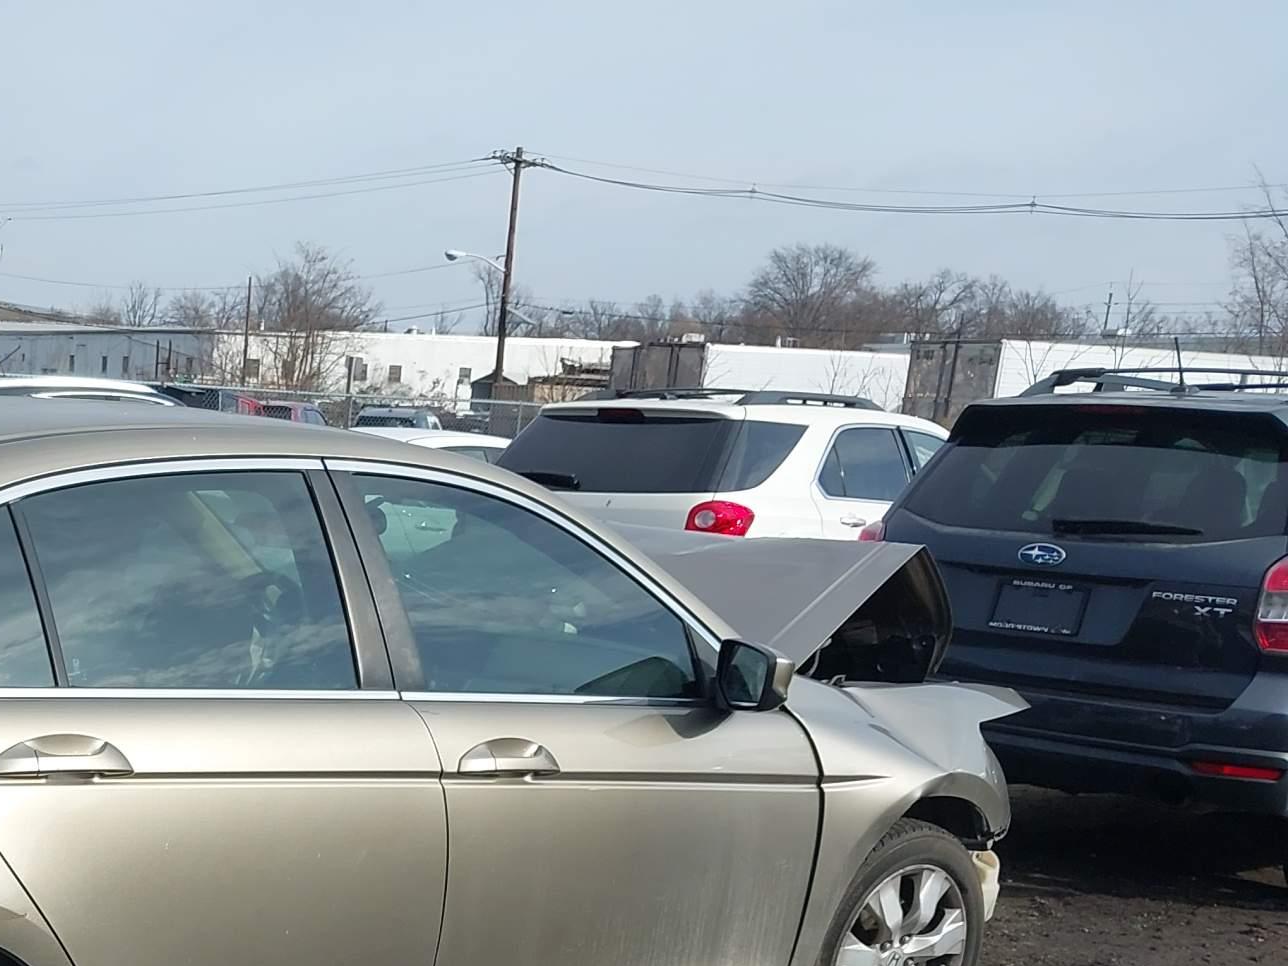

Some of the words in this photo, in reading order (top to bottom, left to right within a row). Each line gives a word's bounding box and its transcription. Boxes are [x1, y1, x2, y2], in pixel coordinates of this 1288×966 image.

[1013, 580, 1056, 589] SUBARU
[1152, 591, 1238, 605] FORESTER
[1194, 606, 1233, 618] XT
